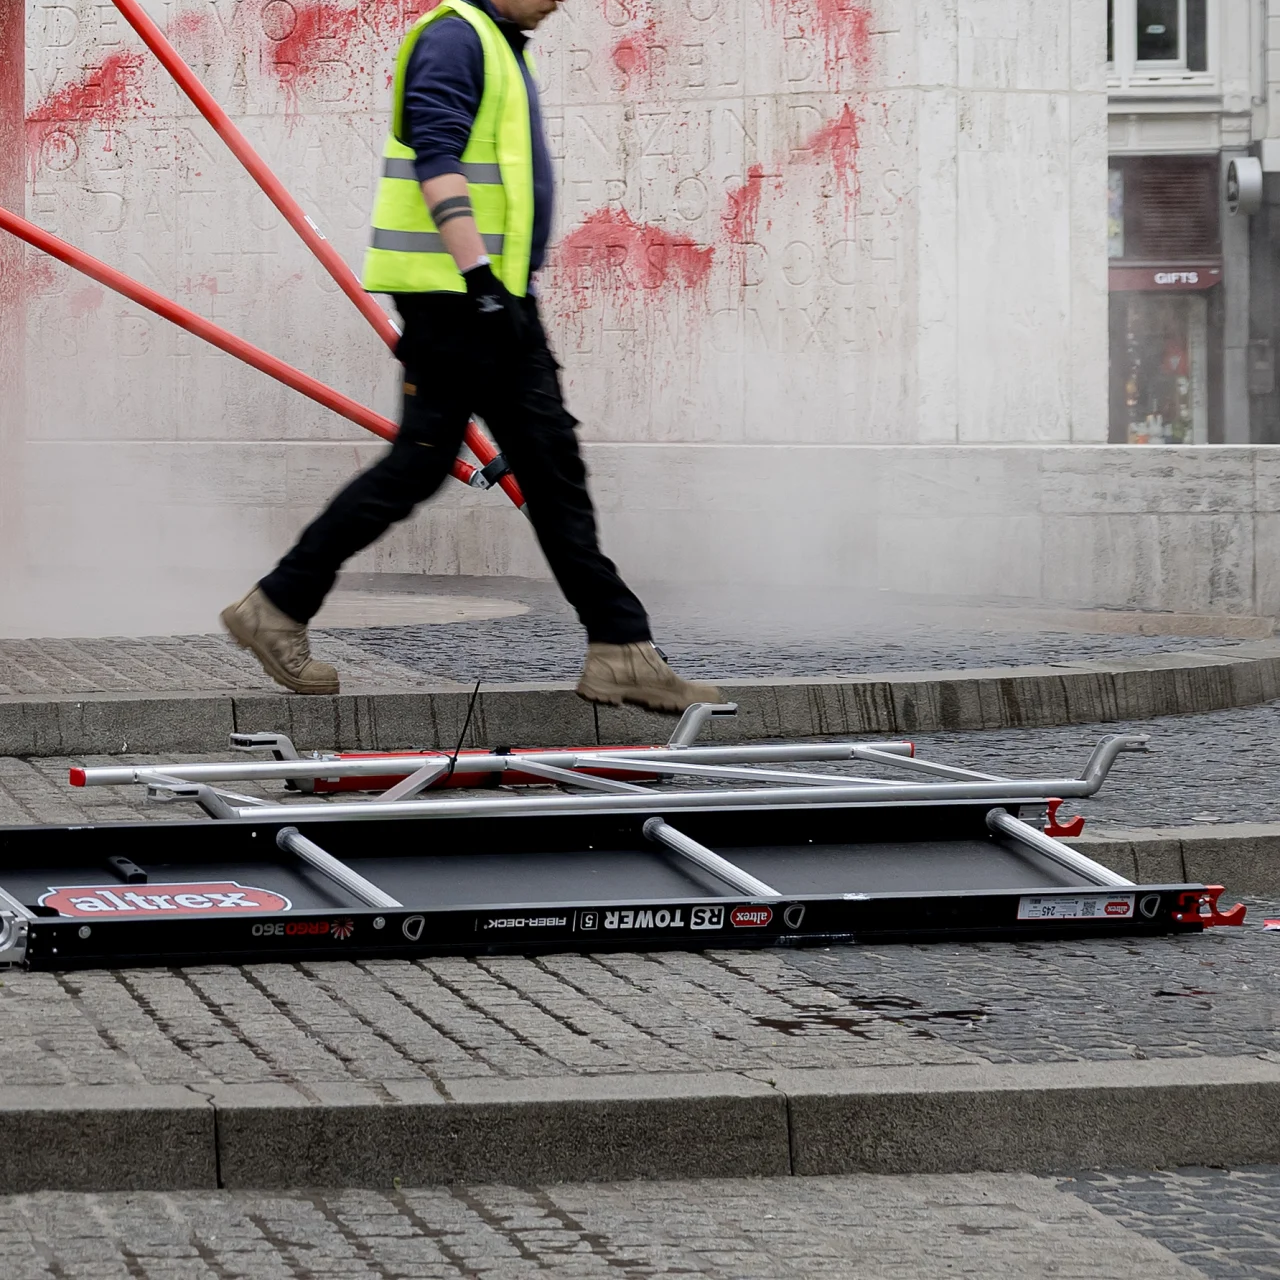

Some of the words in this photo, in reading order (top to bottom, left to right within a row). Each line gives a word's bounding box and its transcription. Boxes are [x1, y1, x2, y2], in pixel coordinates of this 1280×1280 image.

[739, 237, 898, 290] DOCH
[1154, 271, 1199, 285] GIFTS
[68, 889, 262, 913] altrex
[603, 908, 686, 930] TOWER
[692, 907, 724, 929] RS
[735, 908, 769, 924] altrex
[251, 921, 330, 937] ERGO360
